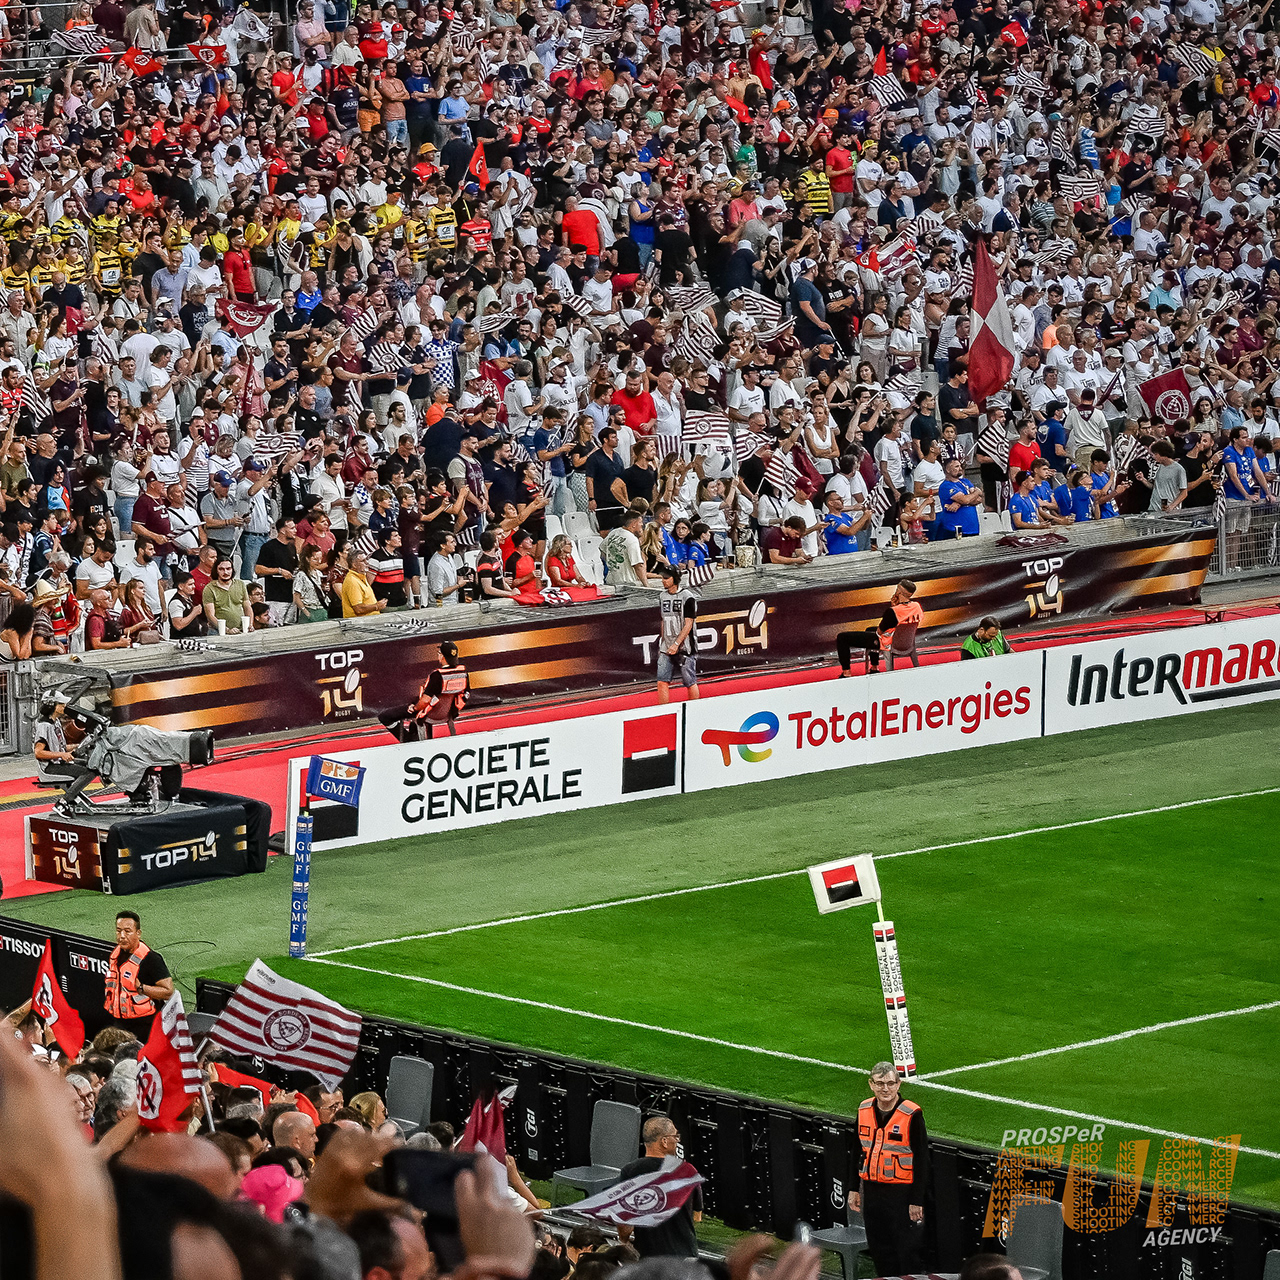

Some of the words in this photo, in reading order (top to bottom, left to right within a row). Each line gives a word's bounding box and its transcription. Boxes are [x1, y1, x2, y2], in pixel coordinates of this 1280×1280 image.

[1021, 556, 1065, 577] TOP
[1025, 589, 1064, 619] 14
[632, 626, 718, 665] TP
[721, 621, 769, 656] 14
[314, 649, 364, 671] TOP
[319, 685, 364, 717] 14
[788, 681, 1031, 749] TotalEnergies
[403, 737, 550, 787] SOCIETE
[320, 778, 353, 798] GMF
[401, 768, 582, 824] GENERALE
[48, 827, 79, 844] TOP
[53, 854, 81, 879] 14
[140, 850, 188, 871] TOP
[189, 842, 217, 863] 14
